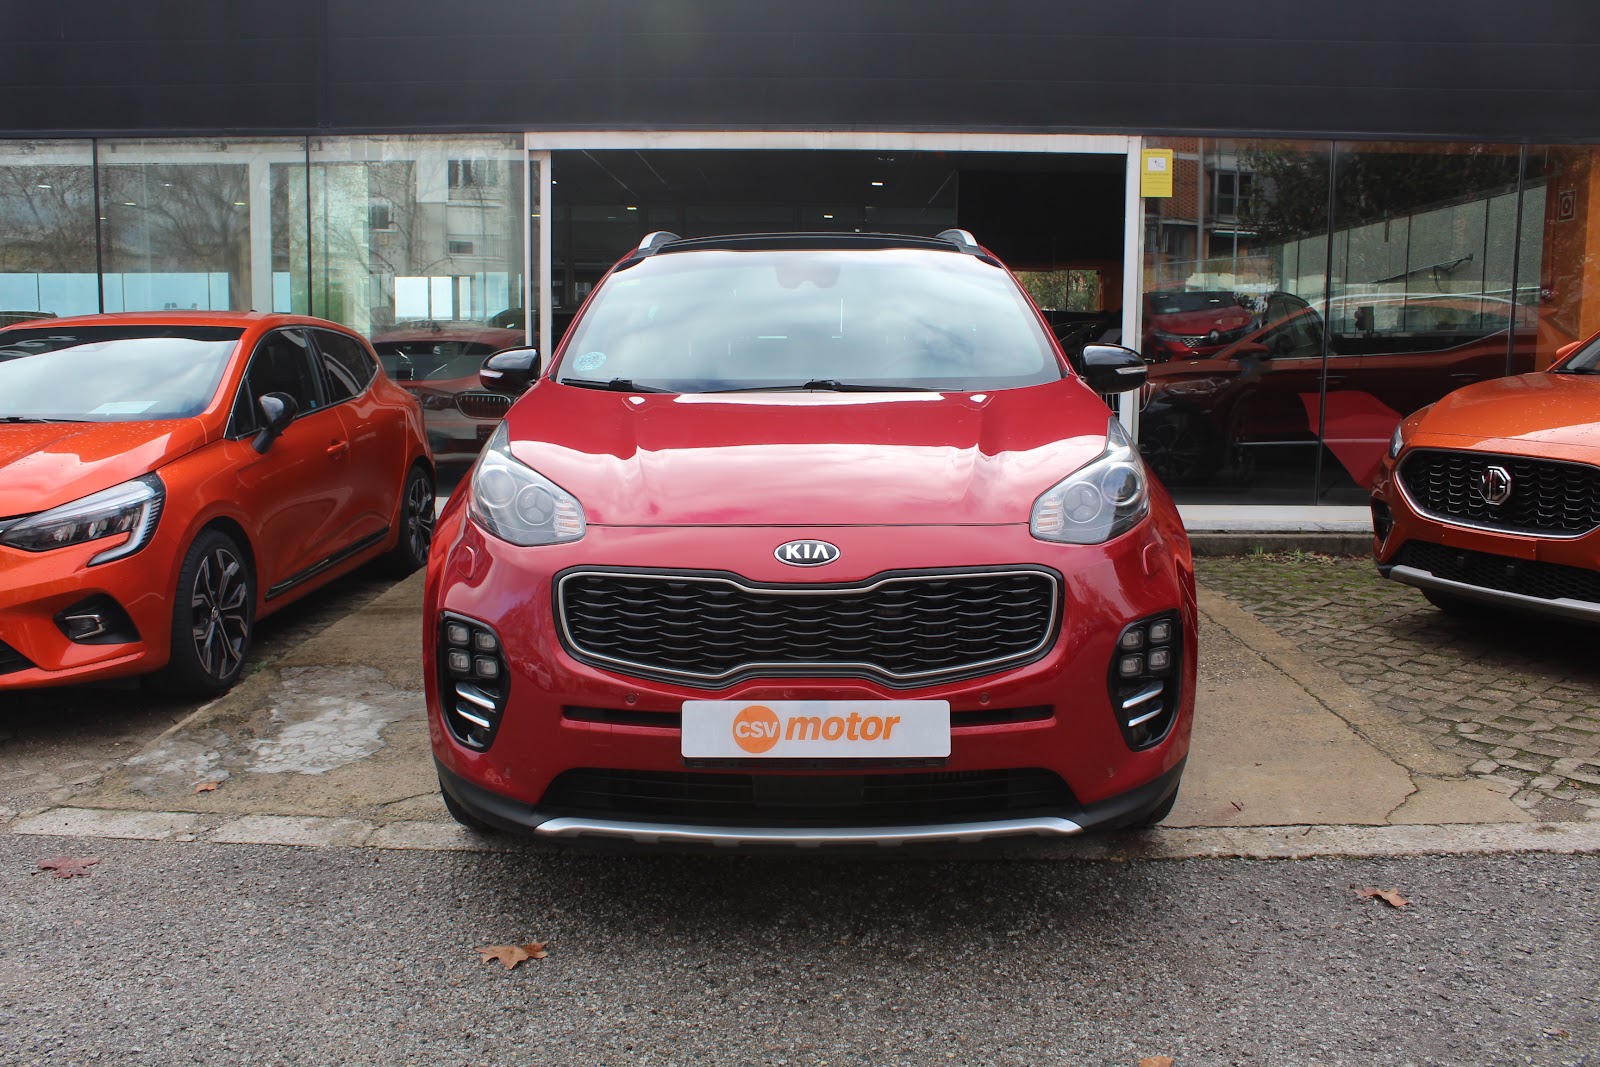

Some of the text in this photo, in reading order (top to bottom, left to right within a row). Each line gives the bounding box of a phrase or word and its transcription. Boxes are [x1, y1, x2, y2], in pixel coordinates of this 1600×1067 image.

[1480, 468, 1507, 501] MG
[785, 543, 830, 560] KIA
[785, 712, 901, 741] motor
